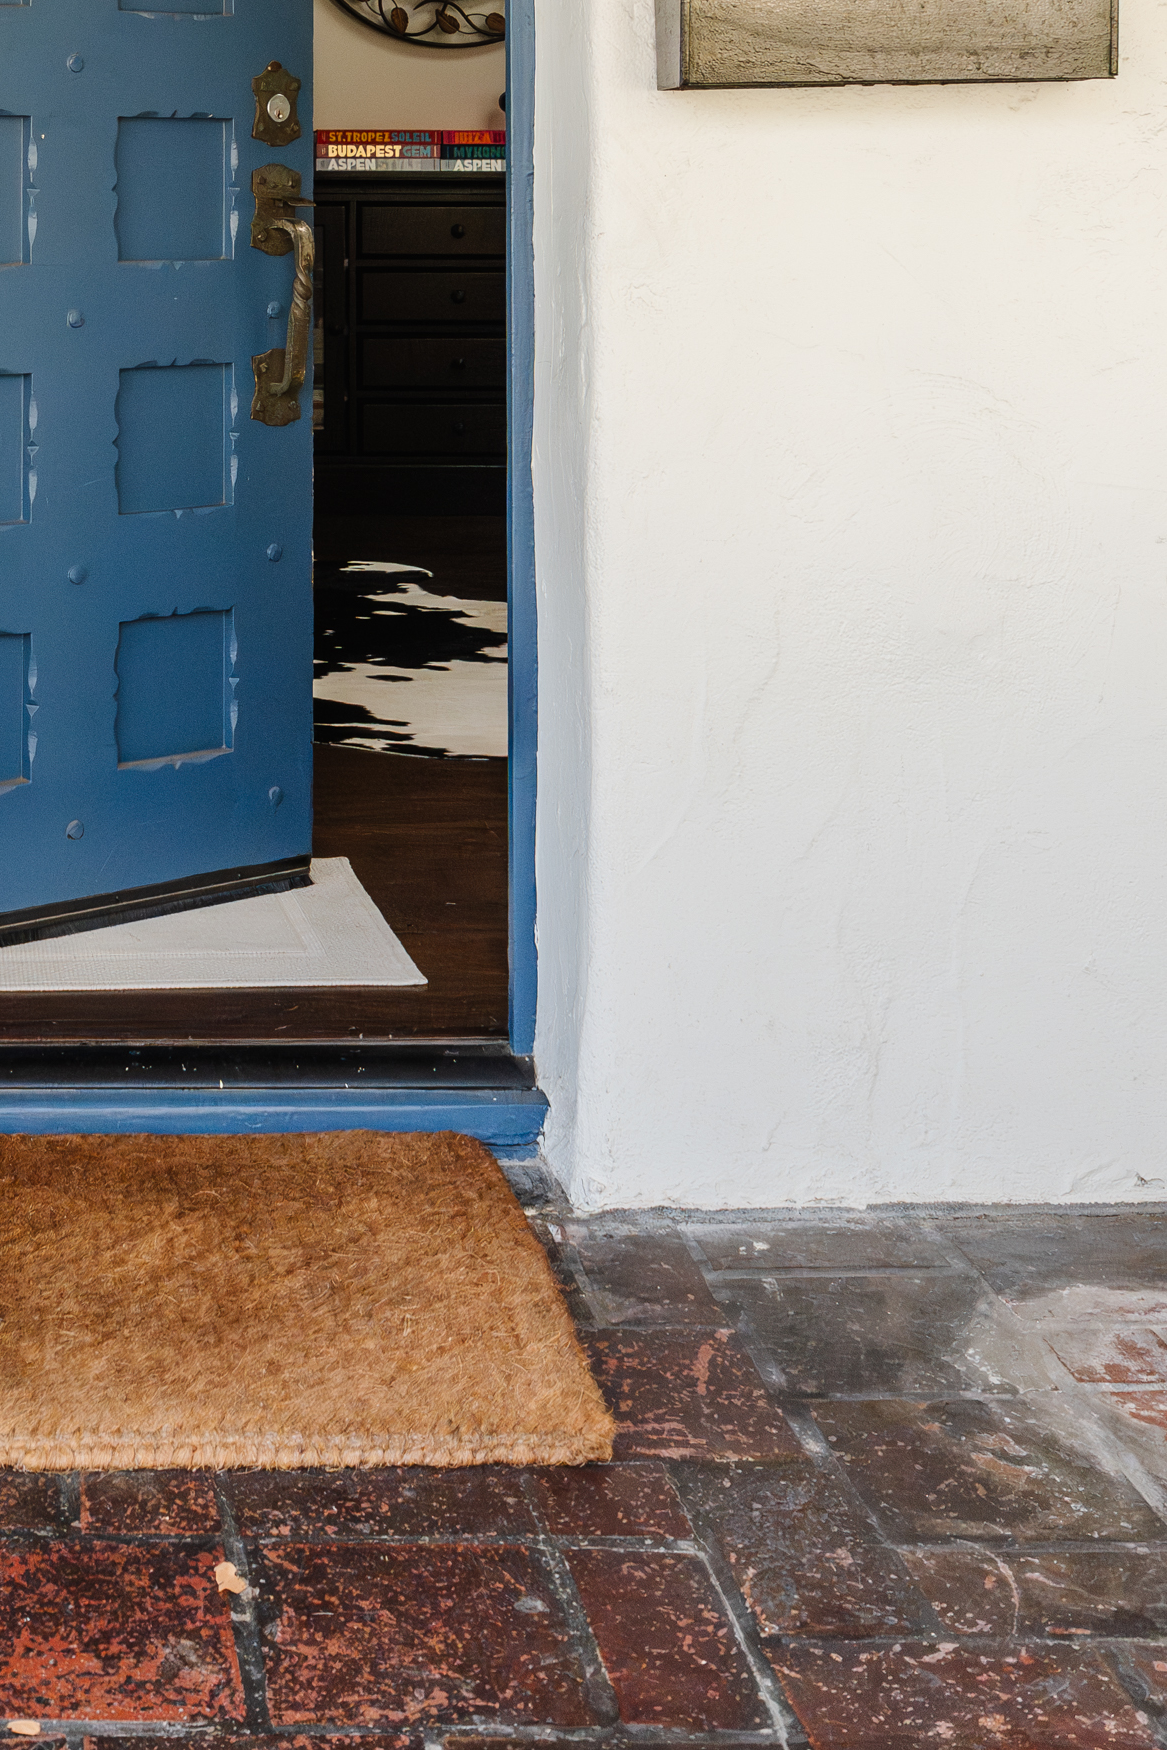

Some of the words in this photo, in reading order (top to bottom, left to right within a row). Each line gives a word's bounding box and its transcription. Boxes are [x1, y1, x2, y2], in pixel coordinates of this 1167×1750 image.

[391, 132, 432, 142] SOLEIL
[328, 145, 402, 157] BUDAPEST
[402, 145, 431, 157] GEM
[328, 158, 376, 170] ASPEN
[452, 159, 502, 172] ASPEN
